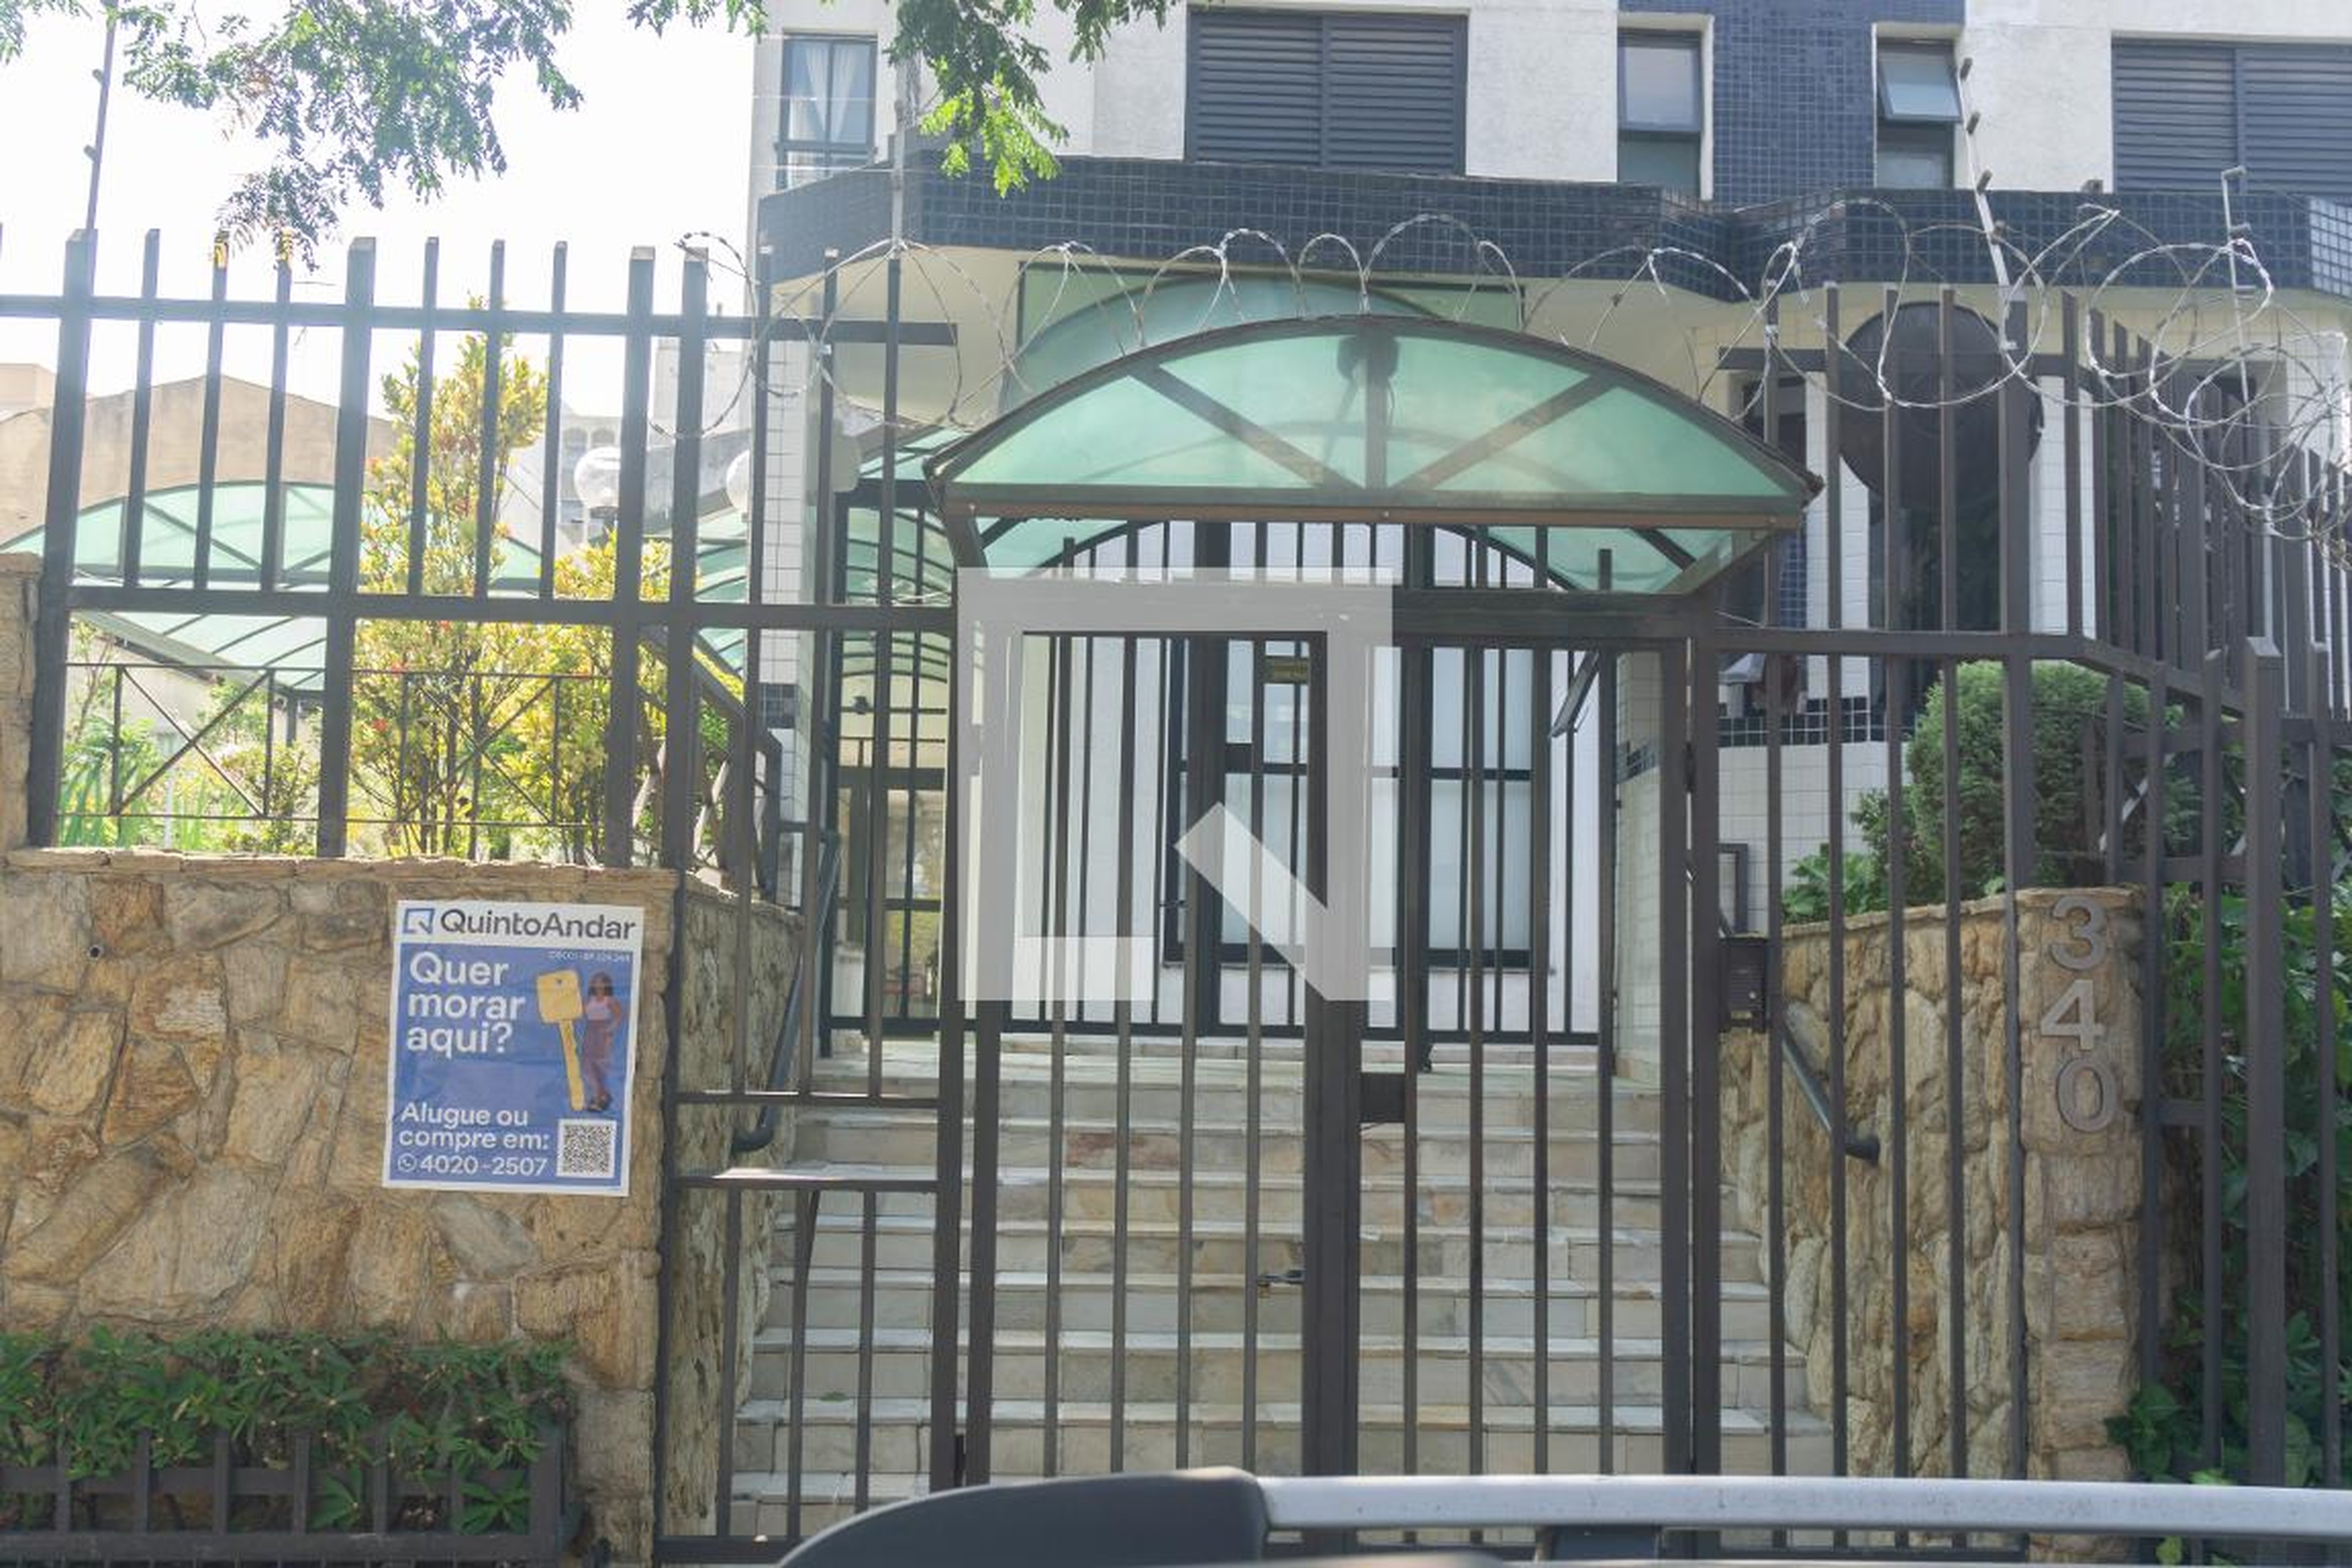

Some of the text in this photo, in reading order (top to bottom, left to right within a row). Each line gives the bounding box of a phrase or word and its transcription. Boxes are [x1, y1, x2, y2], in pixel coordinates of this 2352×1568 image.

[440, 908, 637, 940] QuintoAndar
[409, 951, 510, 986] Quer
[407, 995, 526, 1021] morar
[2040, 896, 2118, 1133] 340
[407, 1021, 513, 1058] aqui?
[401, 1102, 529, 1128] Alugue ou
[399, 1129, 549, 1152] compre em:
